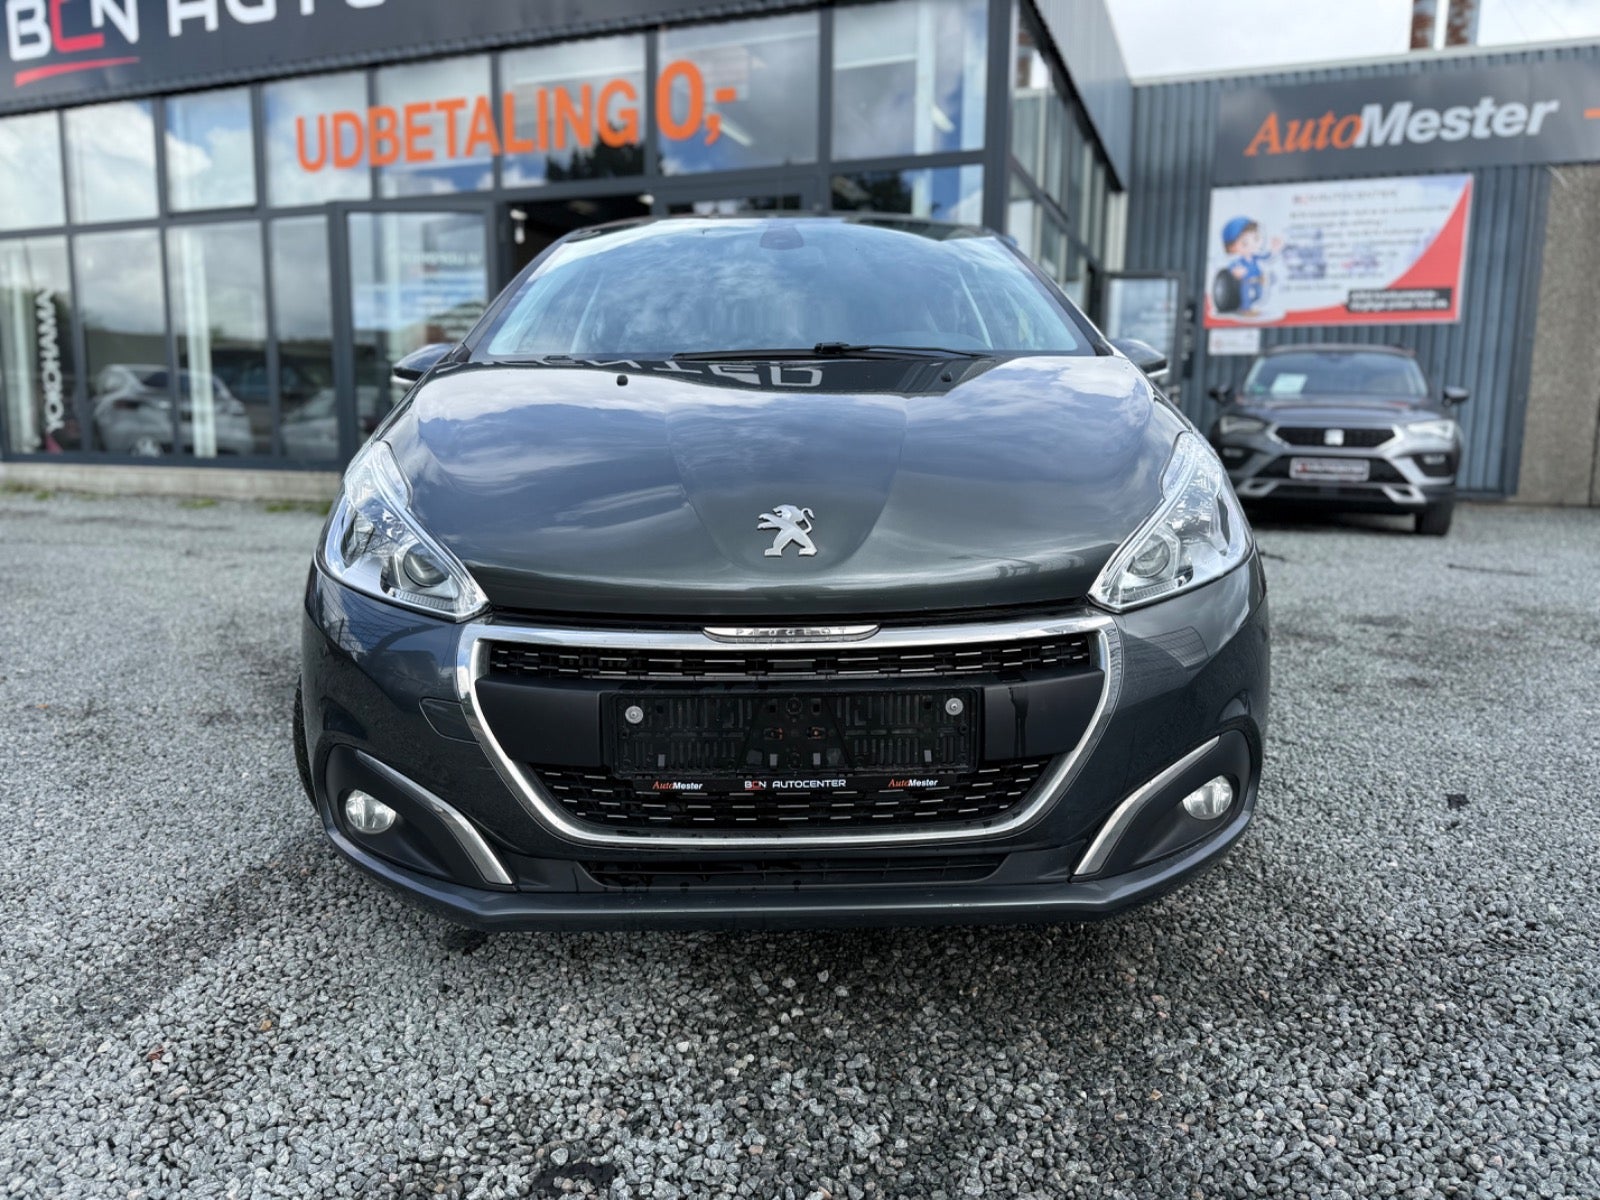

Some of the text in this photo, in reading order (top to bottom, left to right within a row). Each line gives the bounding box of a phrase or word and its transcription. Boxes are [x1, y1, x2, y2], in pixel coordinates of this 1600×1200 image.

[296, 79, 640, 173] UDBETALING
[1243, 96, 1560, 156] AutoMester
[36, 288, 65, 434] YOKOHAMA
[652, 781, 703, 790] AutoMester
[744, 779, 847, 790] BCN AUTOCENTER
[887, 779, 939, 788] AutoMester
